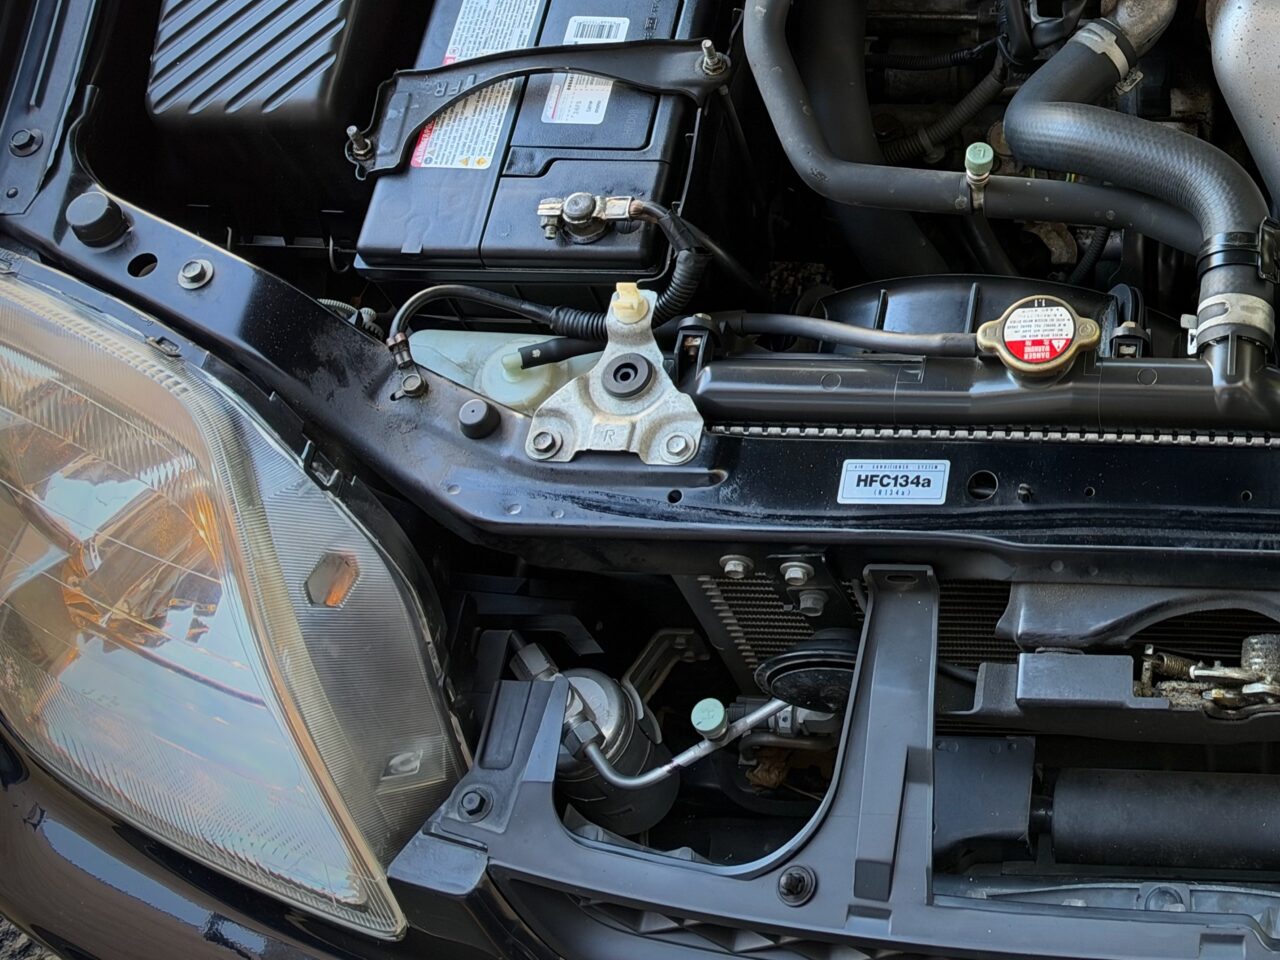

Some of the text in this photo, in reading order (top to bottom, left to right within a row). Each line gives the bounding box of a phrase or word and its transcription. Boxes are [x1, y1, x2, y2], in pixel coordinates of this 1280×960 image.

[603, 429, 616, 442] R
[855, 474, 932, 488] HFC134a
[873, 488, 911, 497] (R134a)
